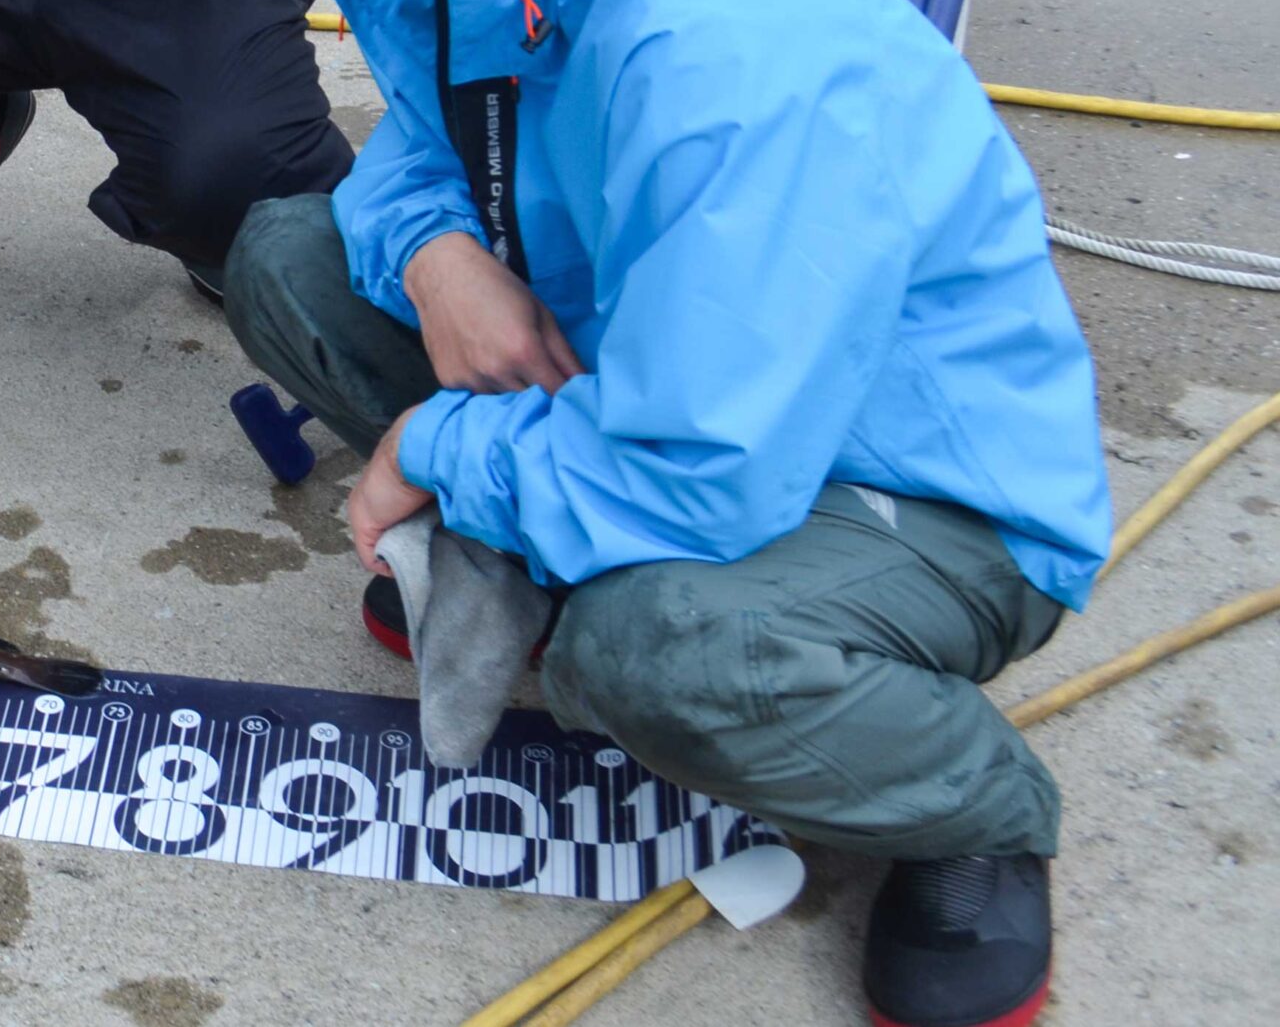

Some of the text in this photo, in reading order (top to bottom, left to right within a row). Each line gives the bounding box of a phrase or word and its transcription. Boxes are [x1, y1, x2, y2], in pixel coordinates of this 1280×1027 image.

[486, 93, 503, 176] MEMBER
[97, 677, 155, 697] RINA
[109, 706, 125, 719] 75
[245, 720, 263, 732] 85
[386, 733, 404, 746] 95
[114, 744, 227, 855] 8
[259, 757, 378, 870] 9
[386, 769, 549, 888] 10
